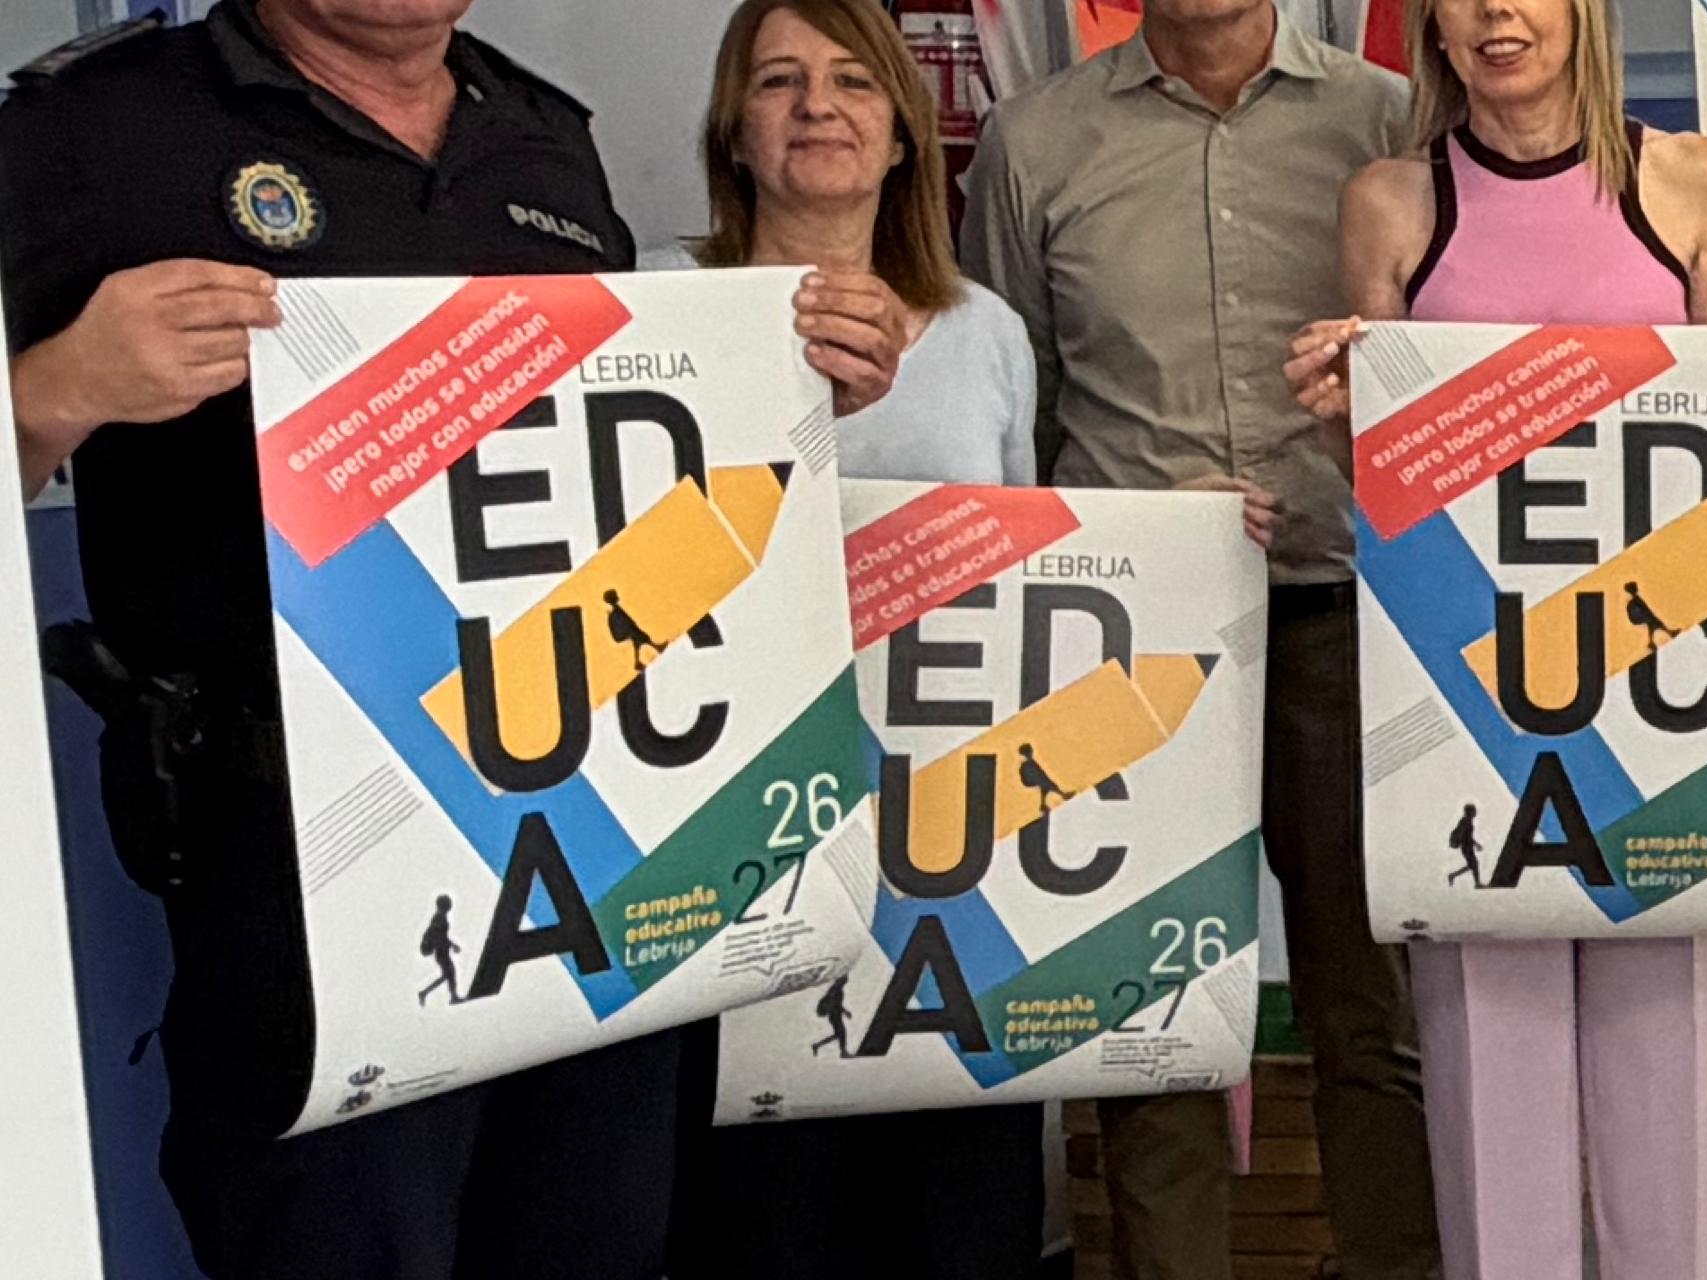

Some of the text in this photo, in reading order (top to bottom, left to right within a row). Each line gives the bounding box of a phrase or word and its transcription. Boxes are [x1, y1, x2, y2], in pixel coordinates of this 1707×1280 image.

[381, 398, 439, 447] todos
[438, 380, 466, 404] se
[466, 312, 549, 385] transitan
[580, 352, 698, 383] LEBRIJA
[288, 409, 369, 473] existen
[368, 352, 448, 416] muchos
[1436, 381, 1507, 429] muchos
[369, 446, 430, 498] mejor
[430, 417, 470, 450] con
[1489, 434, 1520, 461] con
[1023, 555, 1135, 578] LEBRIJA
[763, 772, 842, 848] 26
[733, 852, 806, 924] 27
[1626, 872, 1691, 889] Lebrija
[625, 885, 719, 920] campaña
[625, 911, 722, 943] educativa
[625, 936, 696, 967] Lebrija
[1150, 916, 1228, 973] 26
[1006, 994, 1095, 1016] campaña
[1112, 978, 1187, 1033] 27
[1005, 1016, 1099, 1033] educativa
[1005, 1035, 1072, 1052] Lebrija
